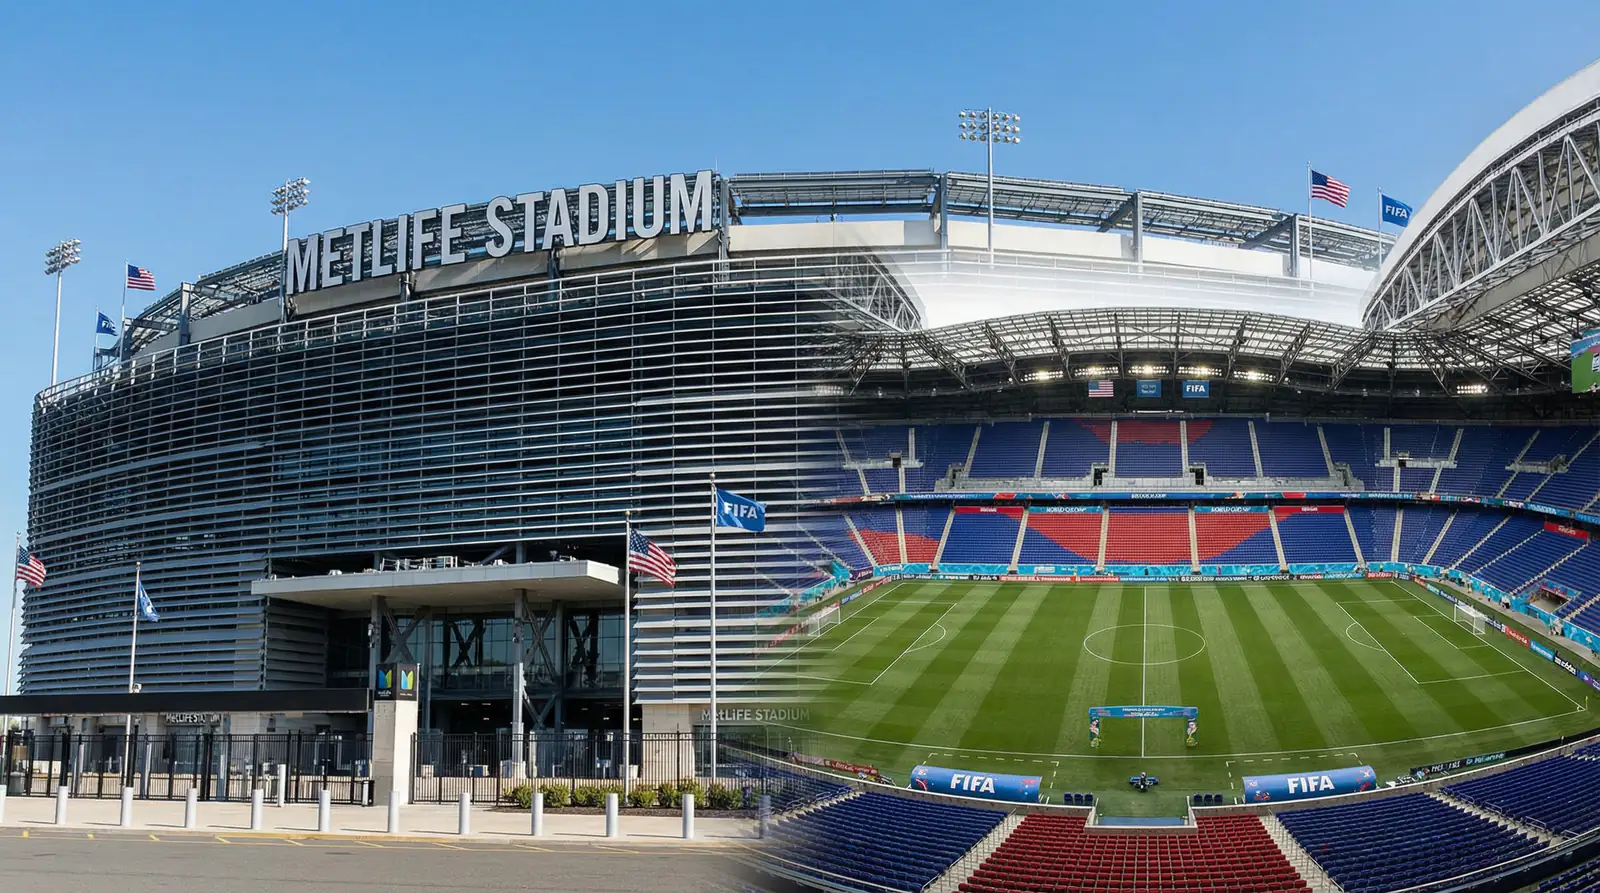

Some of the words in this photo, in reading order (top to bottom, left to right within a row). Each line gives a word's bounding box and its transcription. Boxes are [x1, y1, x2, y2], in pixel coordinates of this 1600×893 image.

[1385, 205, 1408, 218] FIFA
[286, 203, 467, 295] METLIFE
[485, 169, 714, 260] STADIUM
[1186, 384, 1206, 393] FIFA
[723, 501, 758, 519] FIFA
[755, 708, 810, 721] STADIUM
[950, 773, 995, 794] FIFA
[1287, 775, 1336, 794] FIFA
